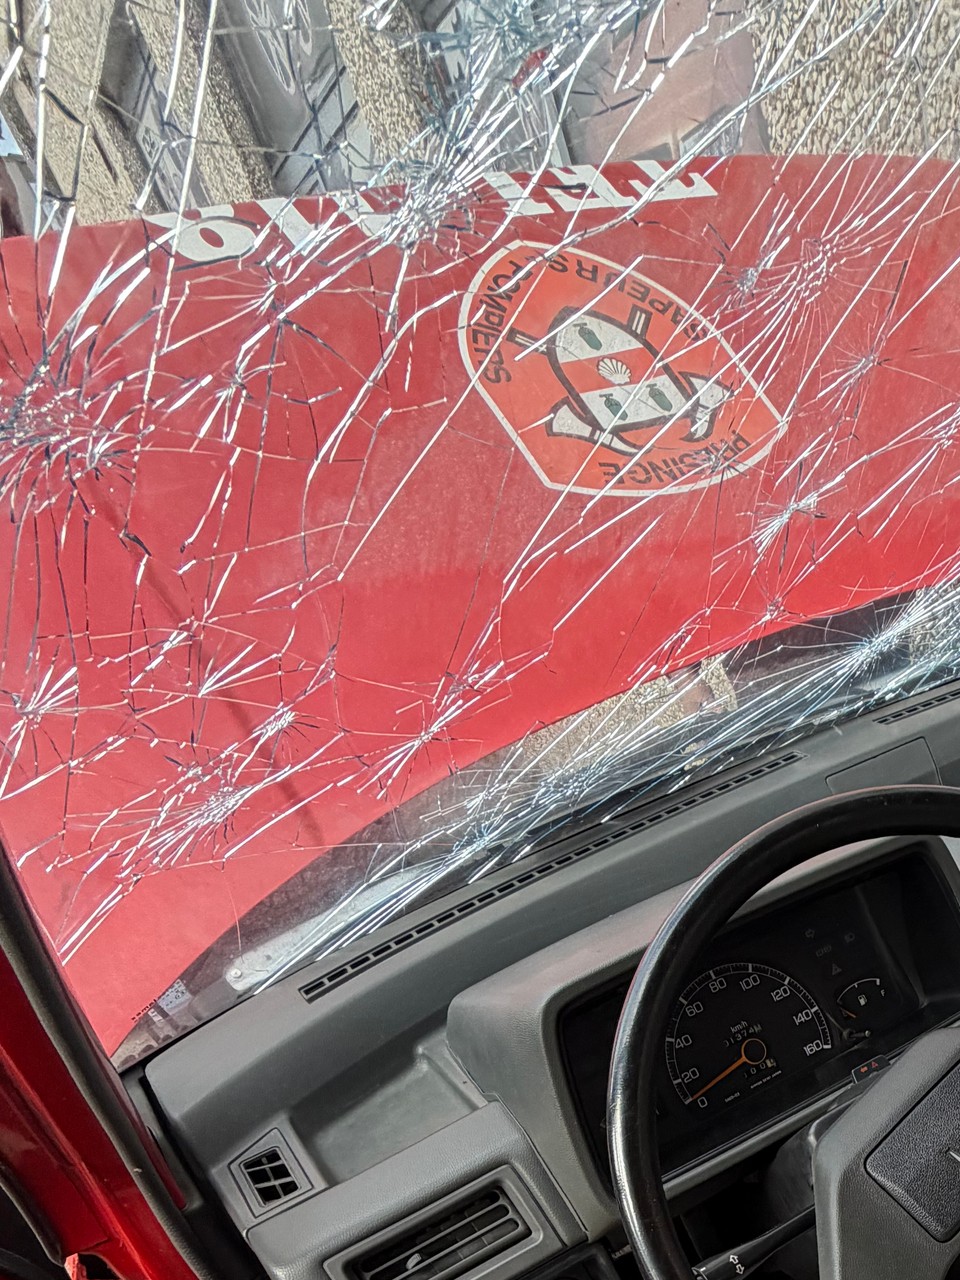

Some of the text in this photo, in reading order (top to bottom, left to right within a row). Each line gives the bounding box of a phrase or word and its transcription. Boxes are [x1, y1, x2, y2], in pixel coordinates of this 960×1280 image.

[708, 977, 727, 993] 80
[739, 973, 761, 992] 100
[770, 986, 791, 1003] 120
[685, 1001, 704, 1017] 60
[792, 1009, 813, 1026] 140
[730, 1019, 749, 1034] km/h
[675, 1034, 693, 1049] 40
[802, 1039, 823, 1057] 160
[681, 1067, 700, 1084] 20
[697, 1096, 709, 1109] 0
